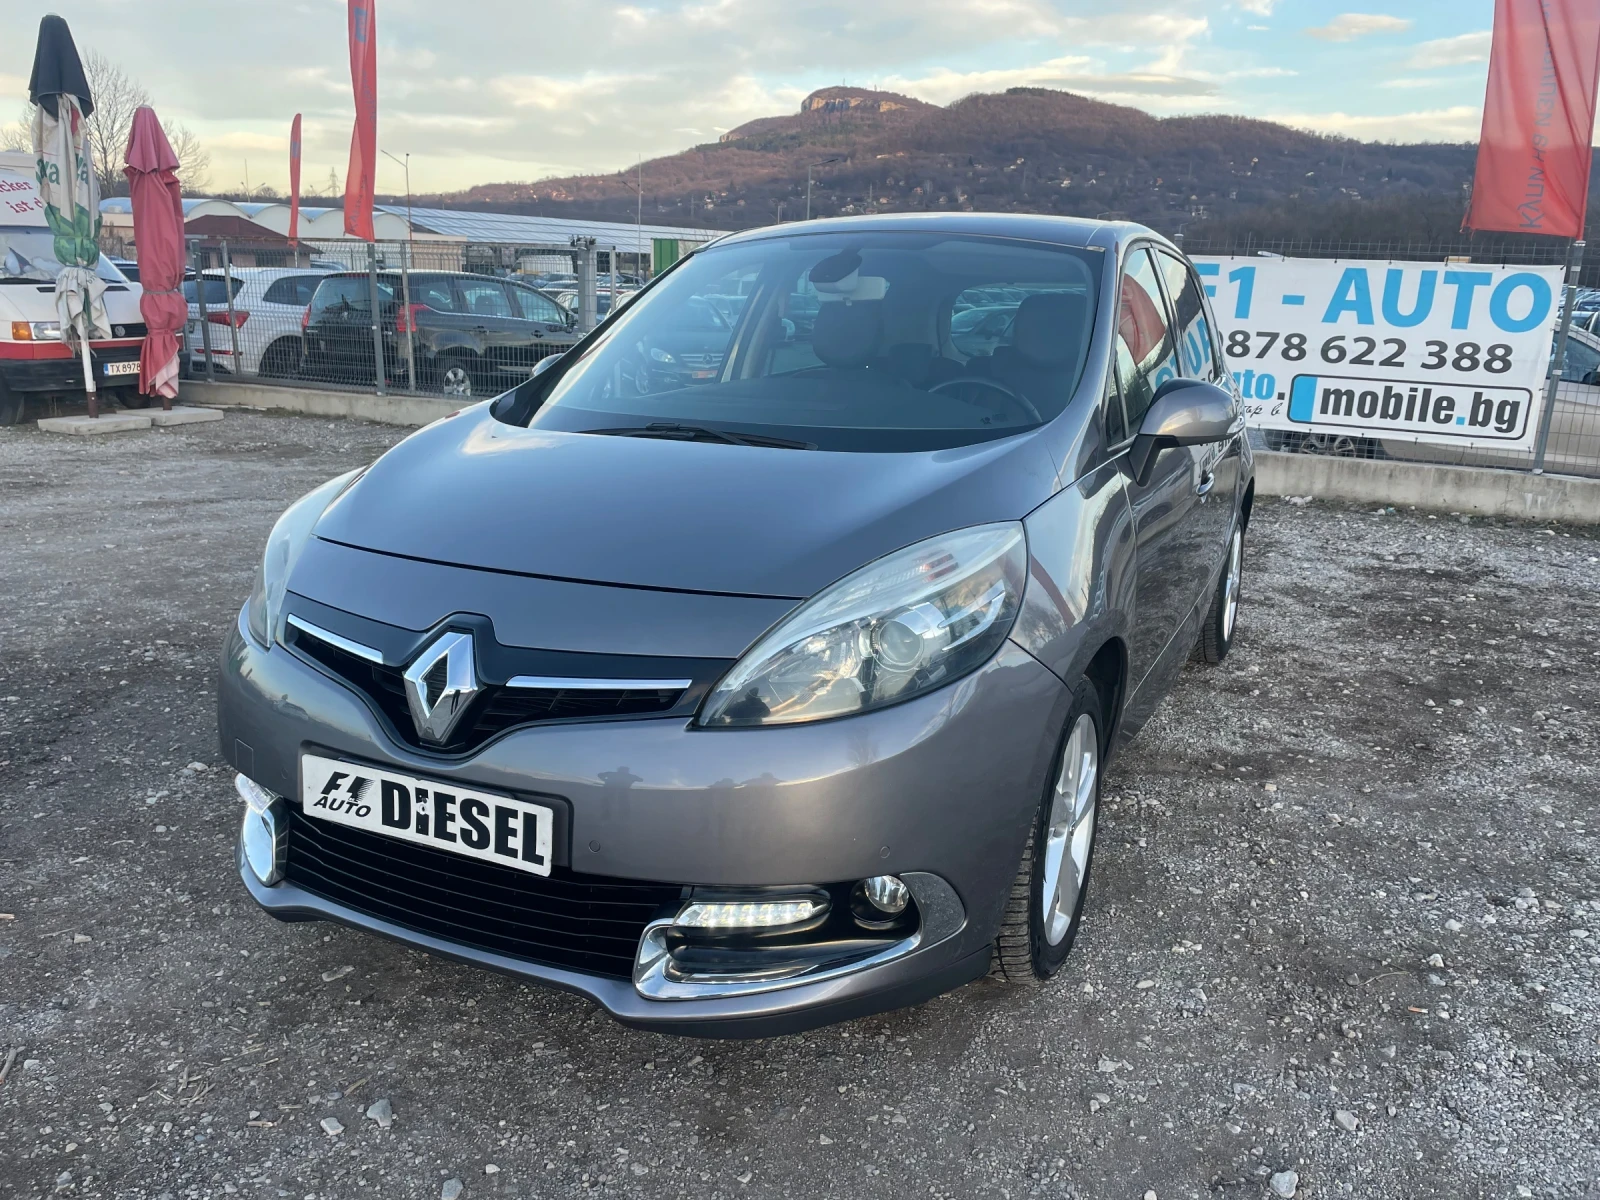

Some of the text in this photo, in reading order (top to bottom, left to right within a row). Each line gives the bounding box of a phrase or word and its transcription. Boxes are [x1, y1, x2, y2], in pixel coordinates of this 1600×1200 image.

[0, 180, 34, 193] cker
[1321, 267, 1552, 333] AUTO
[1219, 329, 1513, 374] 878 622 388
[1319, 385, 1521, 434] mobile.bg
[313, 795, 372, 818] AUTO
[380, 779, 545, 867] DIESEL
